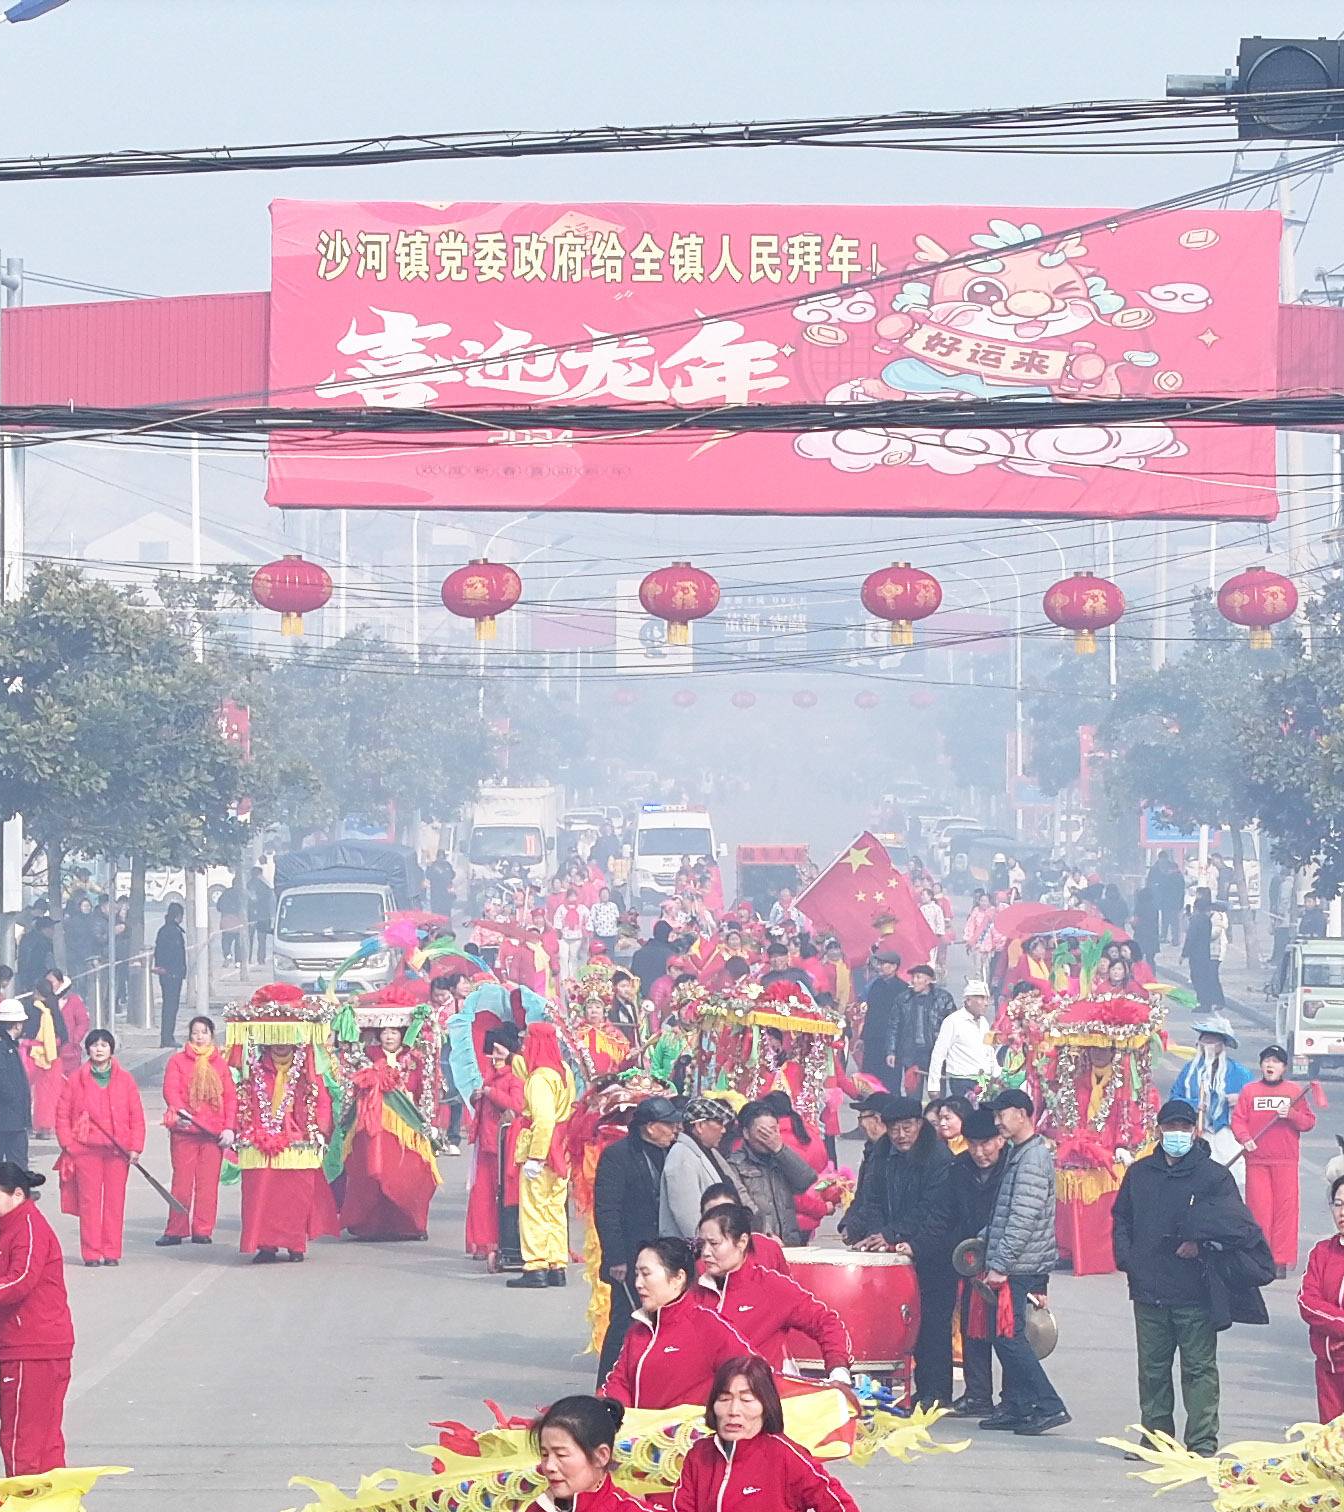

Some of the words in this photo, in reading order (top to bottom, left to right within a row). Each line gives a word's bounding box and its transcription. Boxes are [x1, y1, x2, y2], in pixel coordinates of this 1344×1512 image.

[315, 305, 790, 406] 喜迎龙年
[922, 331, 1050, 375] 好运来
